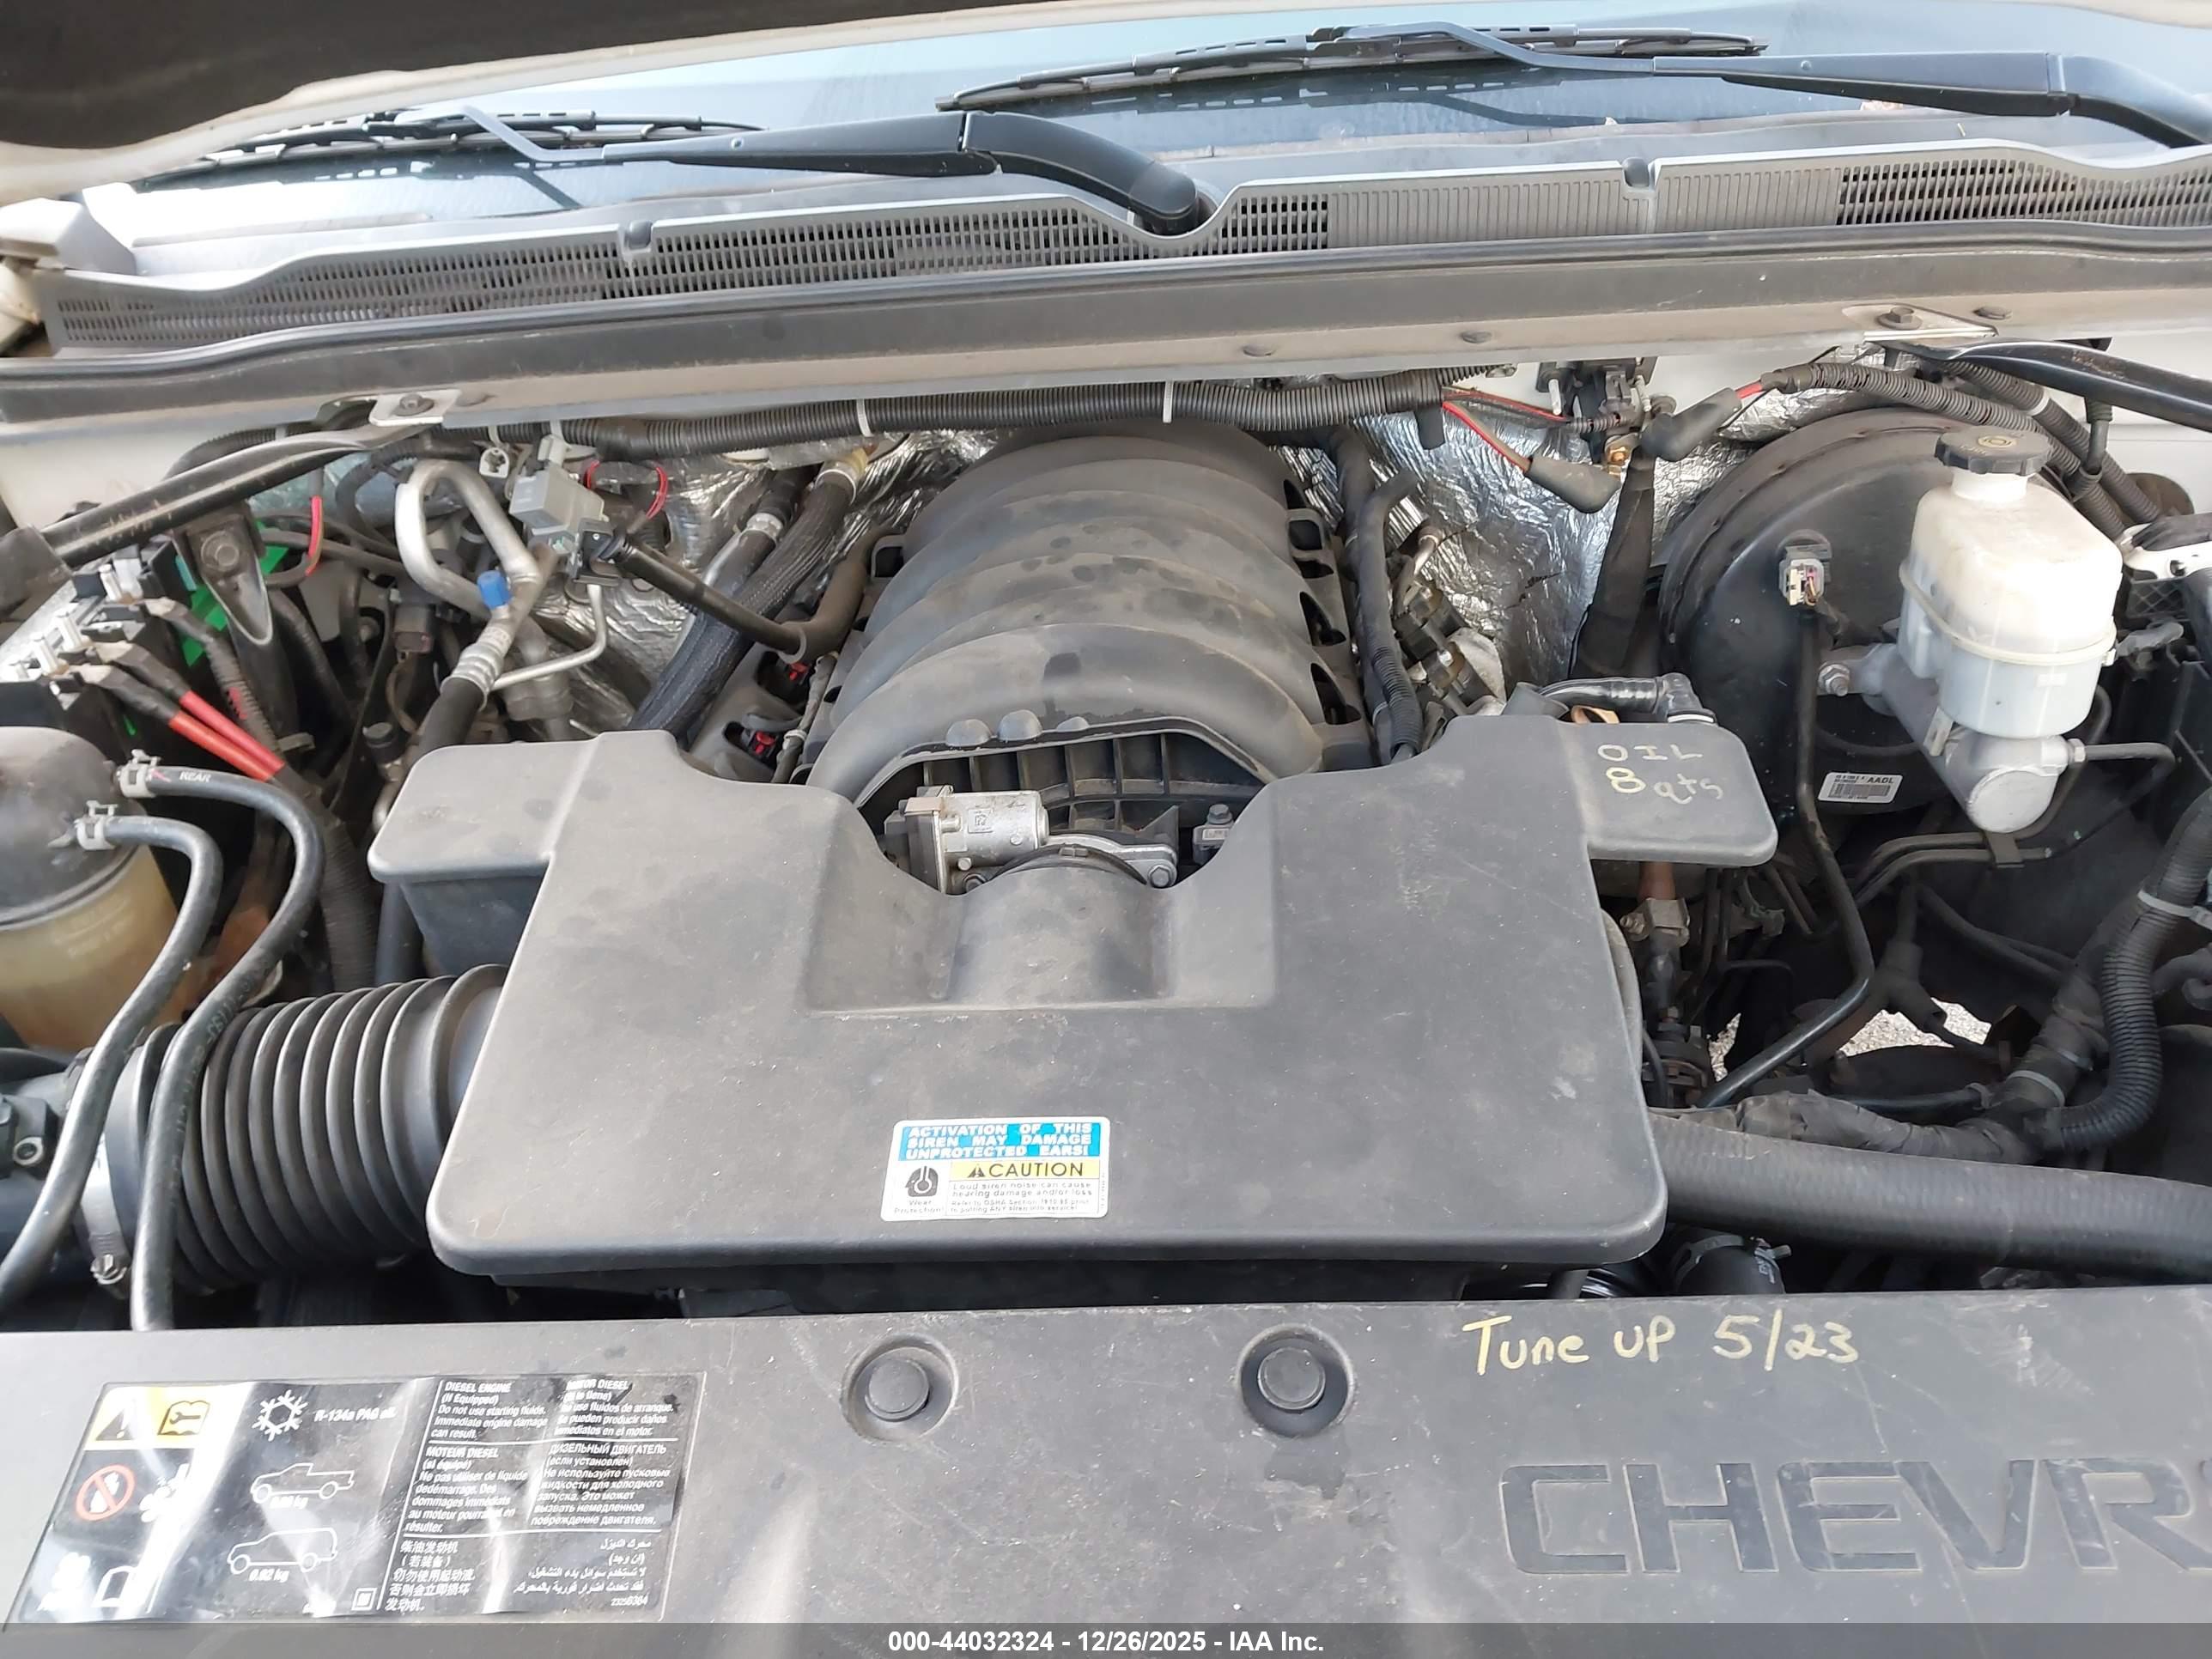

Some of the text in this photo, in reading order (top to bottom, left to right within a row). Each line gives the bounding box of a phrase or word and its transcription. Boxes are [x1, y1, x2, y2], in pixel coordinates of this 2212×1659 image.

[1598, 744, 1703, 762] OIL
[1606, 767, 1647, 793] 8
[908, 1122, 1092, 1137] ACTIVATION OF THIS
[908, 1134, 1091, 1148] SIREN MAY DAMAGE
[906, 1146, 1027, 1159] UNPROTECTED
[989, 1163, 1083, 1178] CAUTION
[1462, 1316, 1589, 1376] Tune
[1713, 1309, 1858, 1371] 5/23
[445, 1382, 512, 1393] DIESEL ENGINE
[598, 1380, 629, 1389] DIESEL
[454, 1394, 499, 1406] Equipped)
[438, 1405, 451, 1414] Do
[453, 1406, 468, 1414] not
[486, 1407, 520, 1417] starting
[574, 1403, 589, 1412] use
[590, 1403, 620, 1413] fluidos
[621, 1403, 633, 1413] de
[634, 1404, 674, 1413] arranque.
[434, 1415, 549, 1429] Immediate engine damage
[569, 1413, 602, 1424] pueden
[603, 1415, 640, 1425] producir
[641, 1414, 667, 1424] daños
[431, 1430, 448, 1438] can
[603, 1427, 614, 1436] en
[615, 1426, 624, 1436] el
[426, 1446, 499, 1458] MOTEUR DIESEL
[549, 1443, 667, 1455] ДИЗЕЛЬНЫЙ ДВИГАТЕЛЬ
[574, 1455, 633, 1467] установлен)
[419, 1471, 433, 1481] Ne
[434, 1473, 452, 1483] pas
[484, 1472, 496, 1480] de
[497, 1471, 528, 1482] liquide
[557, 1468, 622, 1480] используйте
[622, 1469, 670, 1480] пусковые
[590, 1481, 610, 1490] для
[610, 1480, 664, 1490] холодного
[581, 1492, 600, 1500] Это
[602, 1492, 635, 1500] может
[412, 1496, 464, 1510] dommages
[534, 1504, 645, 1513] вызвать немедленное
[408, 1510, 422, 1519] au
[422, 1509, 458, 1520] moteur
[1499, 1459, 2212, 1574] CHEVR
[531, 1515, 600, 1527] повреждение
[400, 1540, 459, 1553] 柴油发动机
